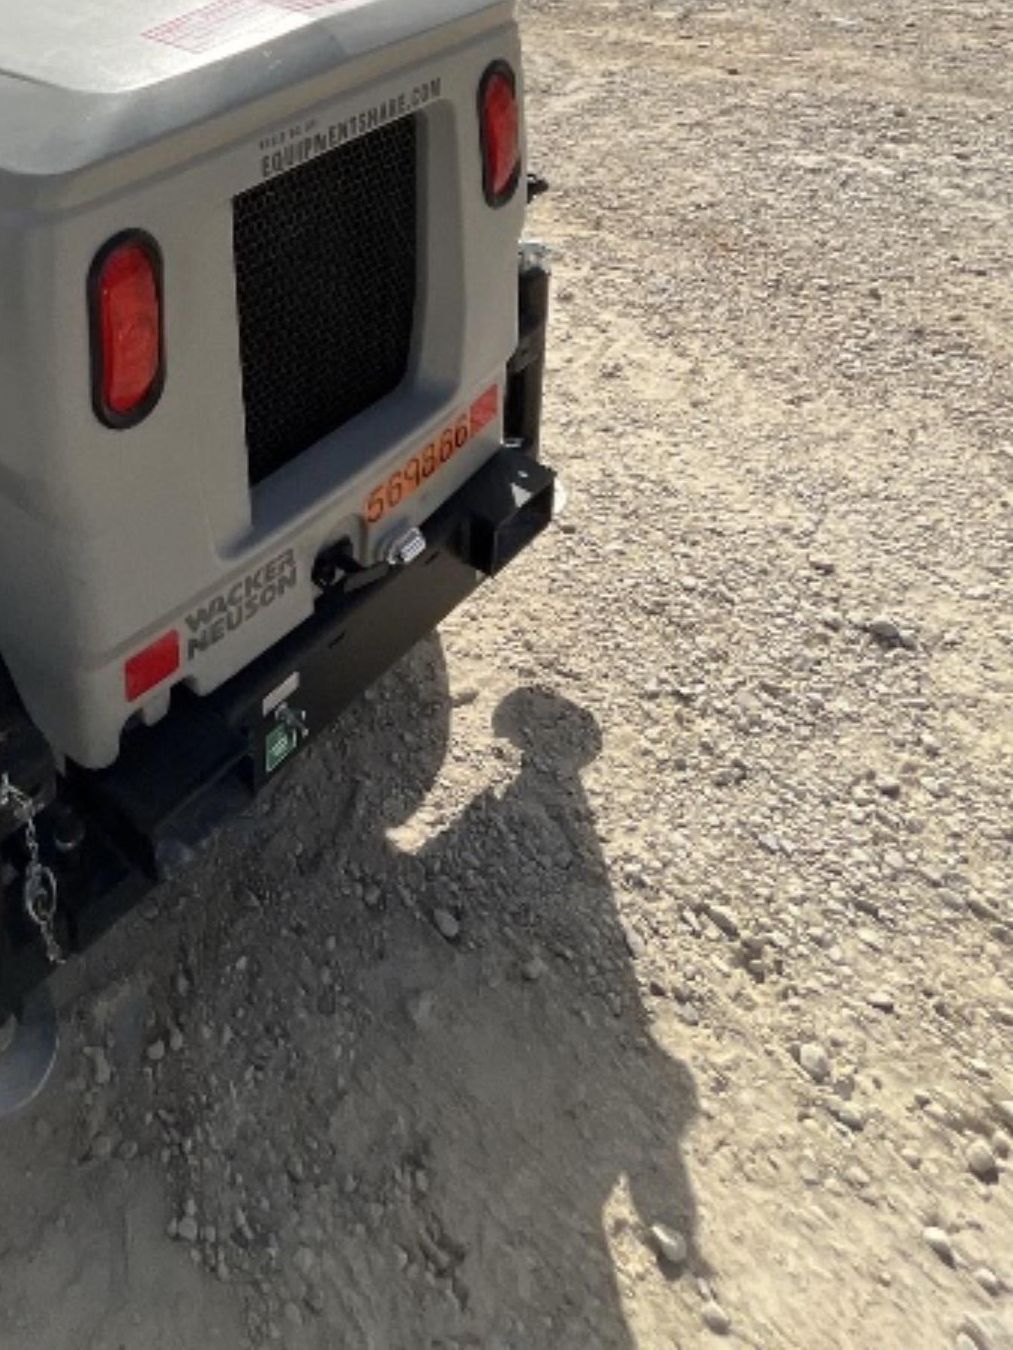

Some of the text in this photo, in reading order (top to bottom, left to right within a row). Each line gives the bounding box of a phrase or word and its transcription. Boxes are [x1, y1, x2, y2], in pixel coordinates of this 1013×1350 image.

[366, 418, 469, 524] 569866
[184, 548, 296, 633] WACKER
[187, 571, 297, 660] NEUSON
